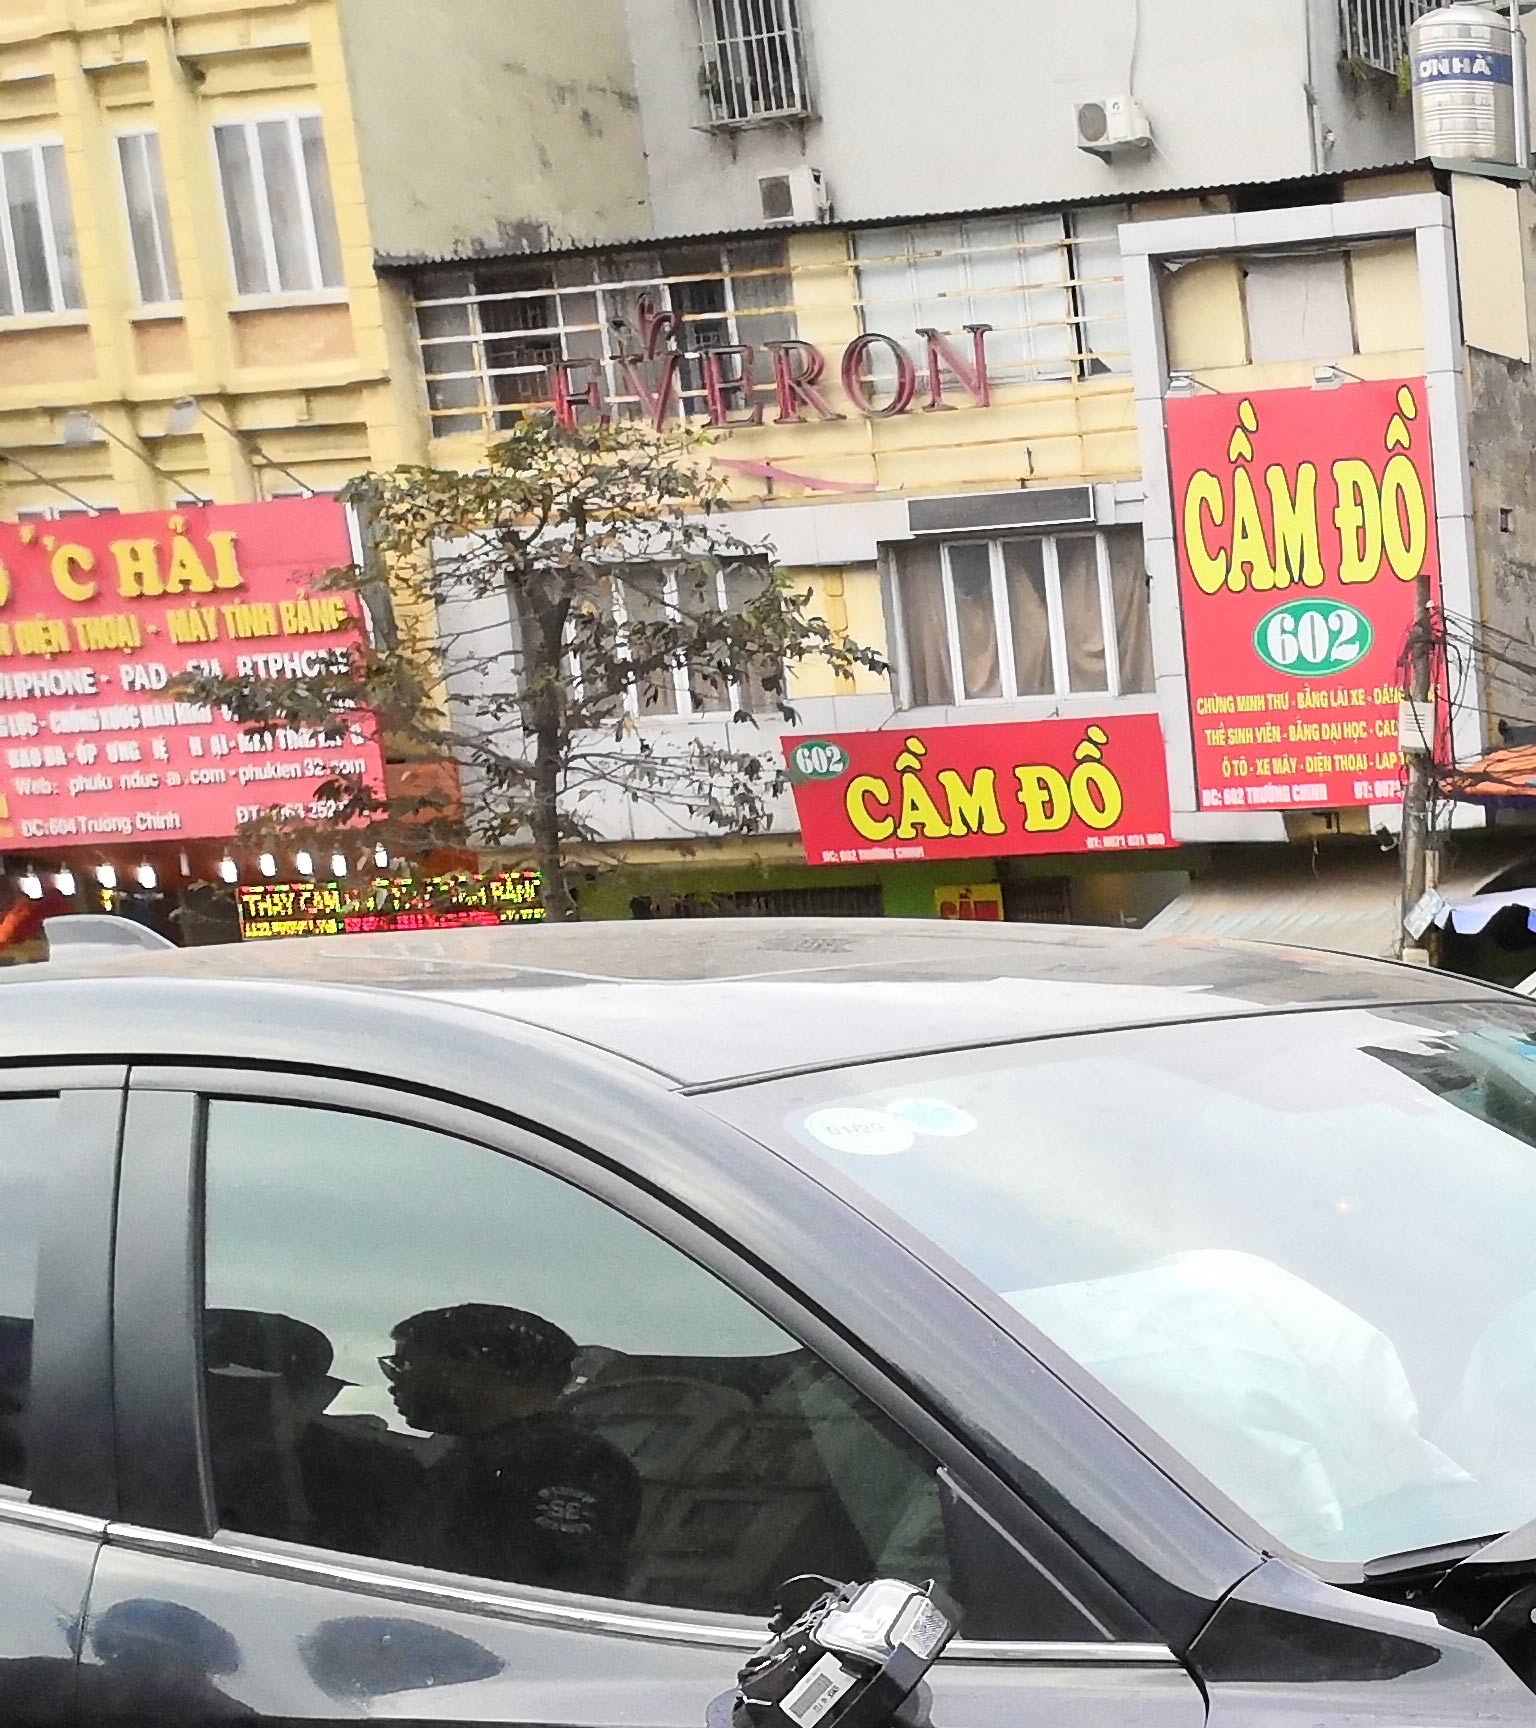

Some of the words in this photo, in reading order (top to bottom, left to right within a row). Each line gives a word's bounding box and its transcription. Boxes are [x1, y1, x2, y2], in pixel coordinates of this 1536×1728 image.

[549, 323, 993, 433] EVERON
[1184, 398, 1325, 594] CẦM
[1331, 384, 1428, 586] ĐỒ
[110, 514, 243, 599] HẢI
[1266, 609, 1360, 667] 602
[119, 662, 168, 691] PAD
[1350, 688, 1366, 706] XE
[1228, 727, 1254, 745] SINH
[1255, 722, 1281, 744] VIÊN
[1344, 722, 1367, 745] HỌC
[795, 746, 844, 774] 602
[845, 736, 1006, 842] CẦM
[1014, 724, 1123, 833] ĐỒ
[1256, 758, 1271, 775] XE
[1375, 753, 1396, 770] LAP
